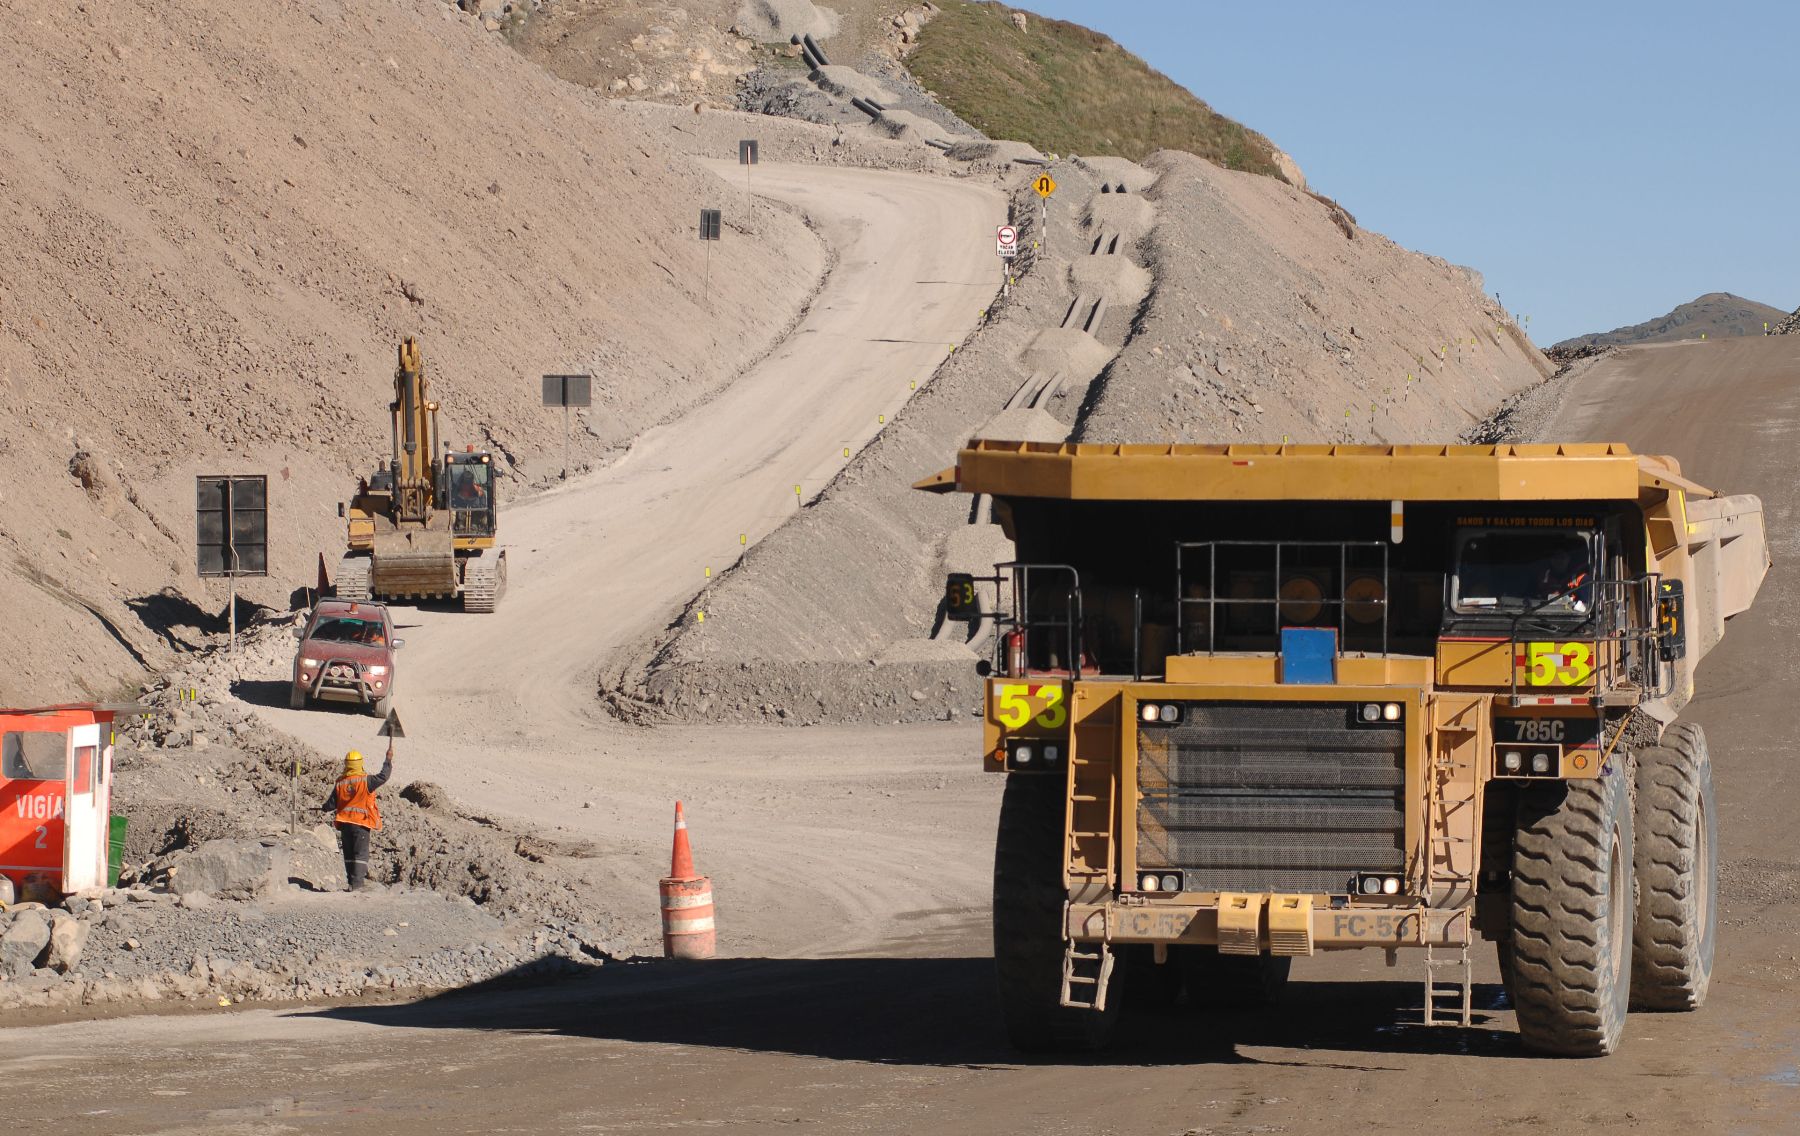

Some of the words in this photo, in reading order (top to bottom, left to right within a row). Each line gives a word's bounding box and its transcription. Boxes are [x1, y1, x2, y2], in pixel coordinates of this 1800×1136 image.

[1456, 517, 1484, 526] SANOS
[1486, 517, 1491, 526] Y
[1494, 517, 1525, 526] SALVOS
[1528, 517, 1553, 526] TODOS
[1557, 518, 1573, 526] LOS
[1525, 641, 1590, 686] 53
[999, 683, 1067, 729] 53
[1514, 720, 1565, 741] 785C
[16, 793, 65, 820] VIGÍA
[35, 825, 47, 848] 2
